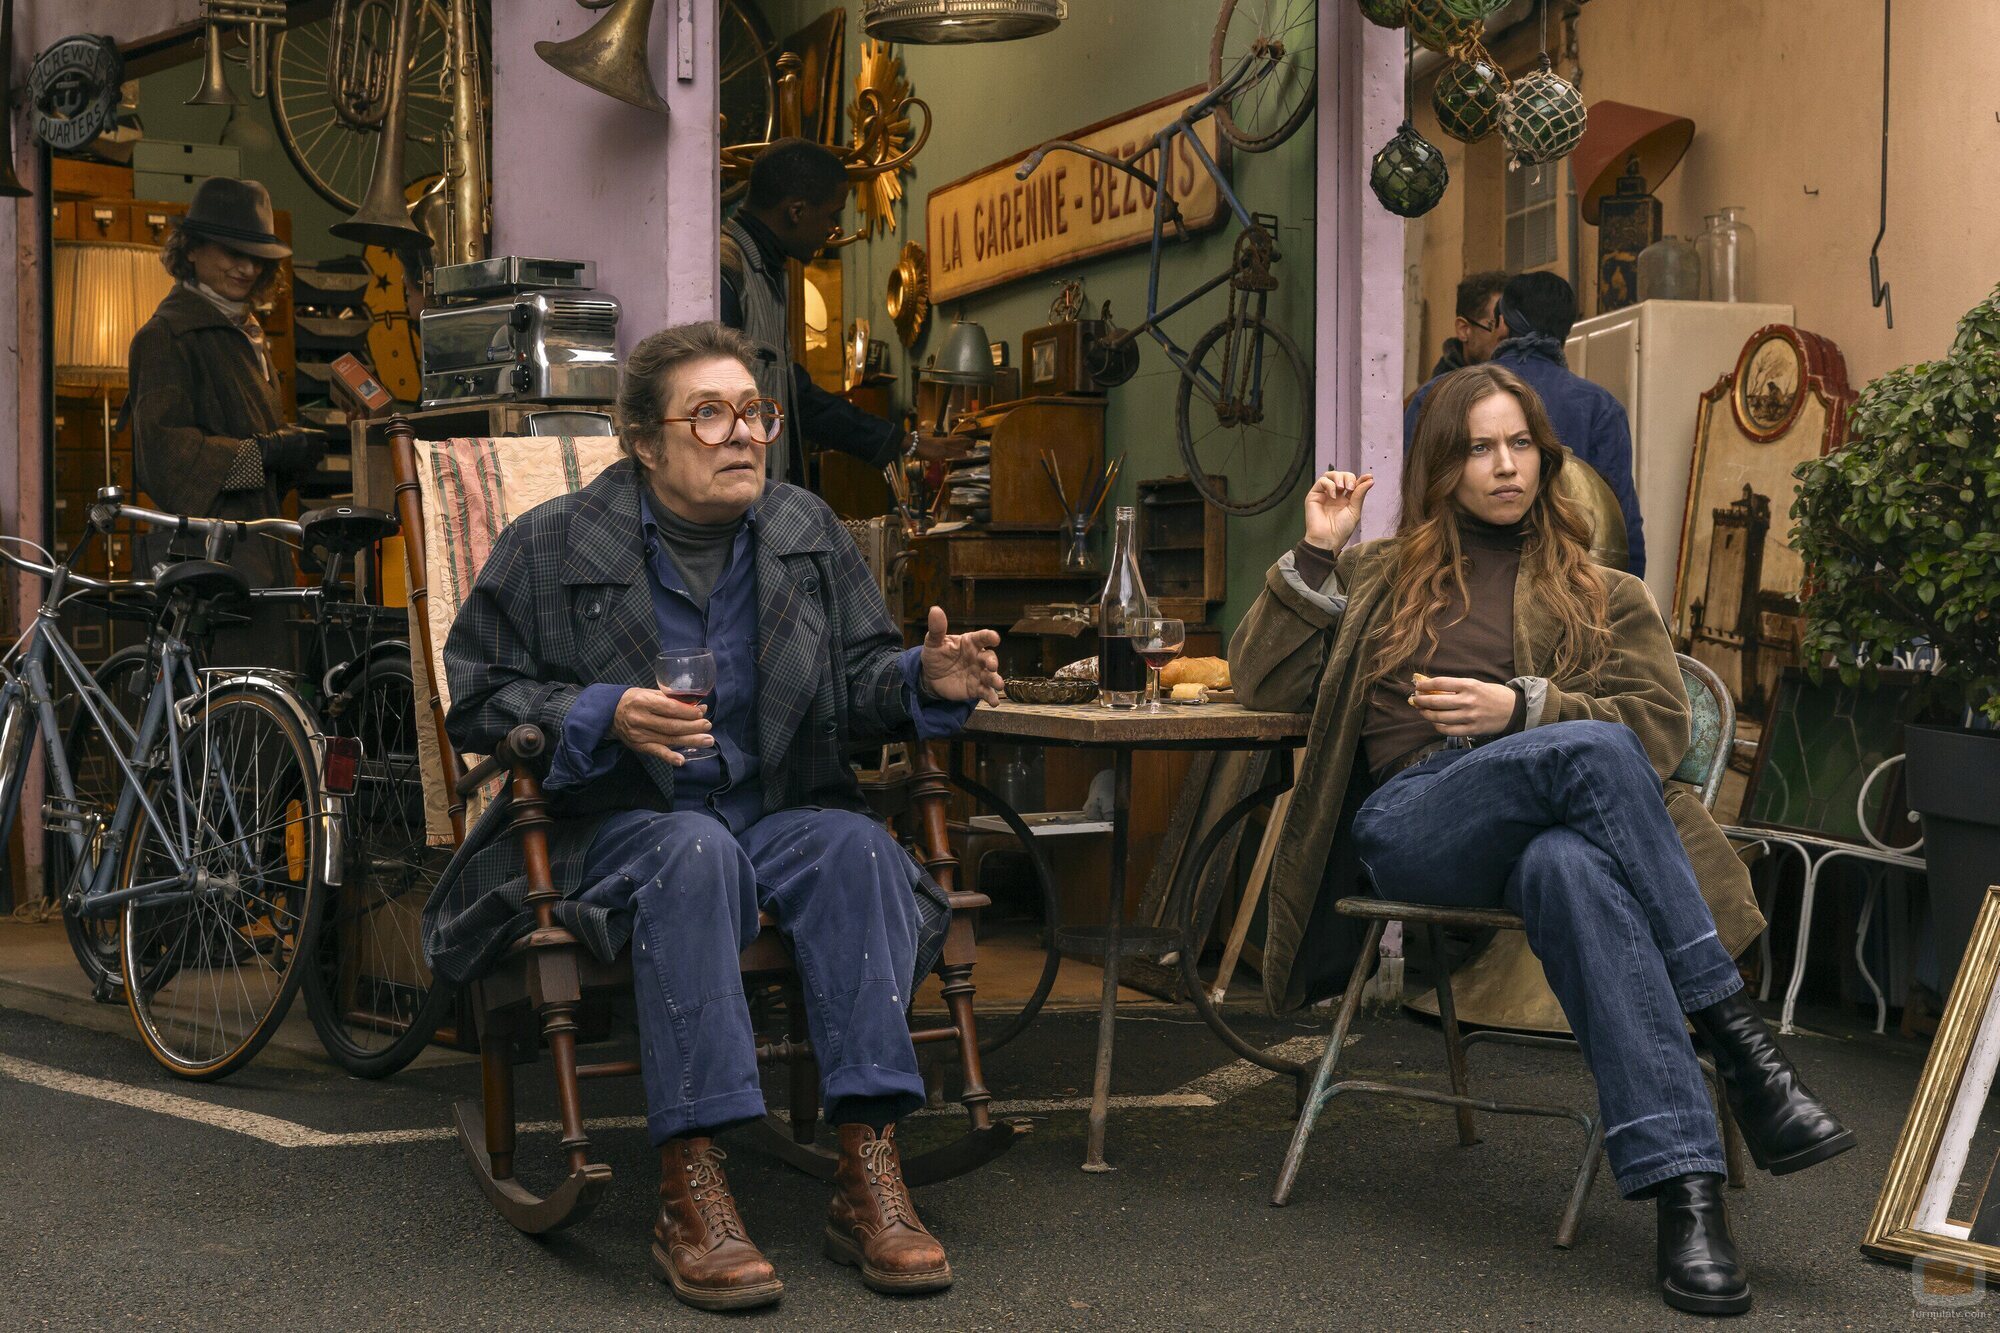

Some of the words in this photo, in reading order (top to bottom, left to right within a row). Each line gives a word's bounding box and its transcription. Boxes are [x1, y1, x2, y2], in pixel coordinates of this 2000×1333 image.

[42, 45, 95, 77] CREWS
[39, 103, 101, 144] QUARTERS
[941, 210, 963, 273] LA
